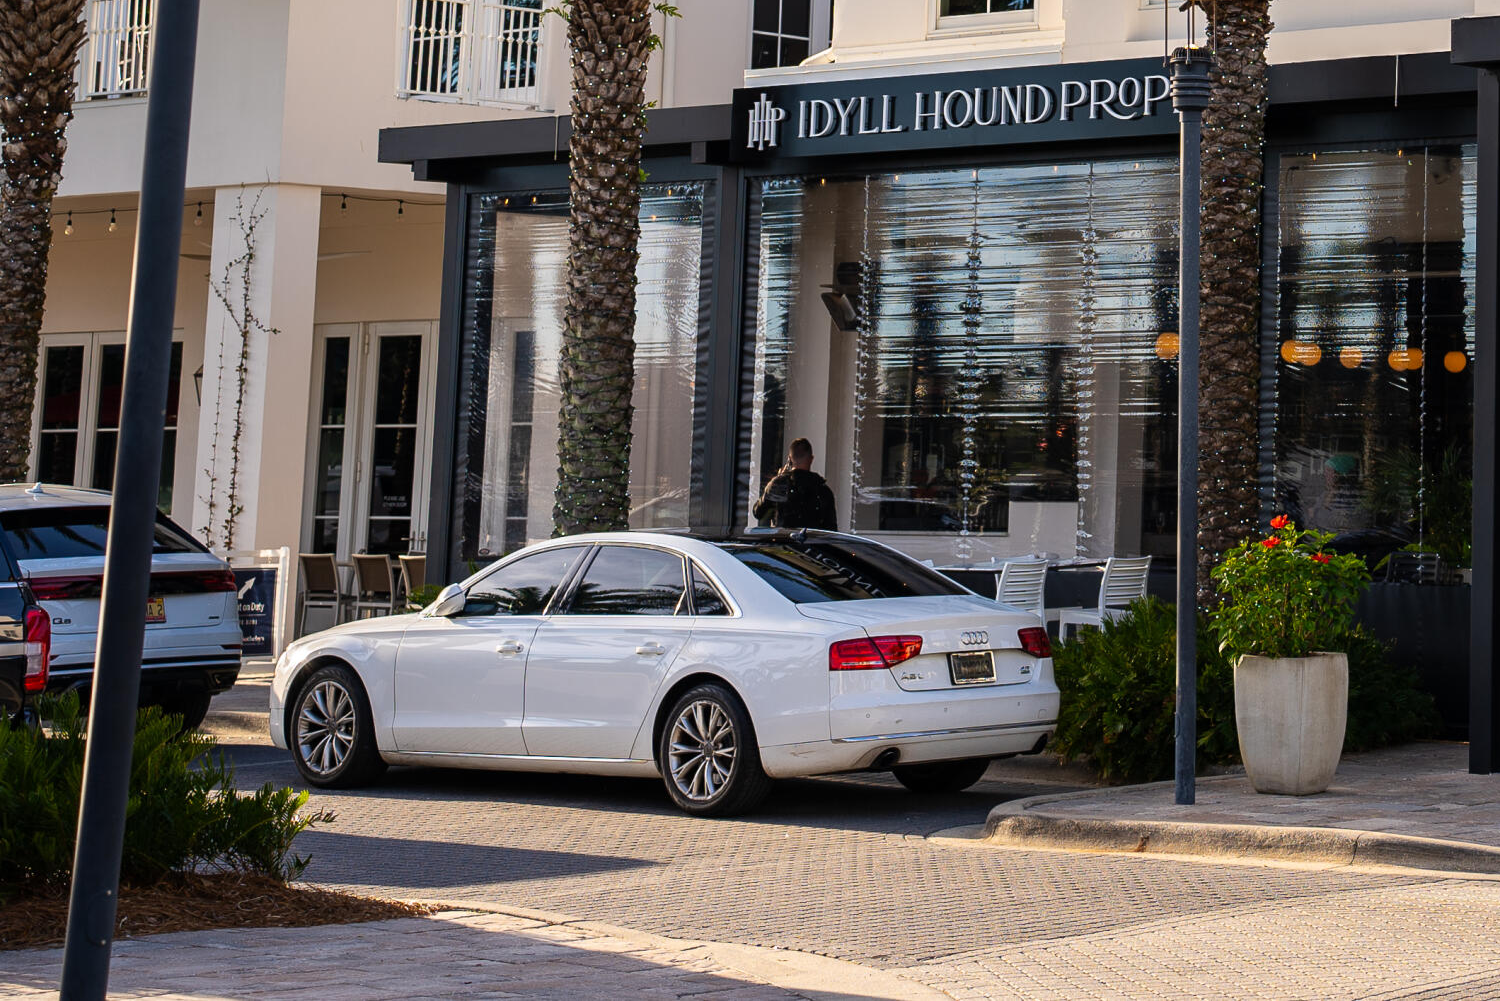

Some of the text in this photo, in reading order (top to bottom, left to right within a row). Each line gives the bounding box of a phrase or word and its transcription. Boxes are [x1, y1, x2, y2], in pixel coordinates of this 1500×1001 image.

[797, 74, 1180, 138] IDYLL HOUND PROP
[250, 602, 265, 613] Duty
